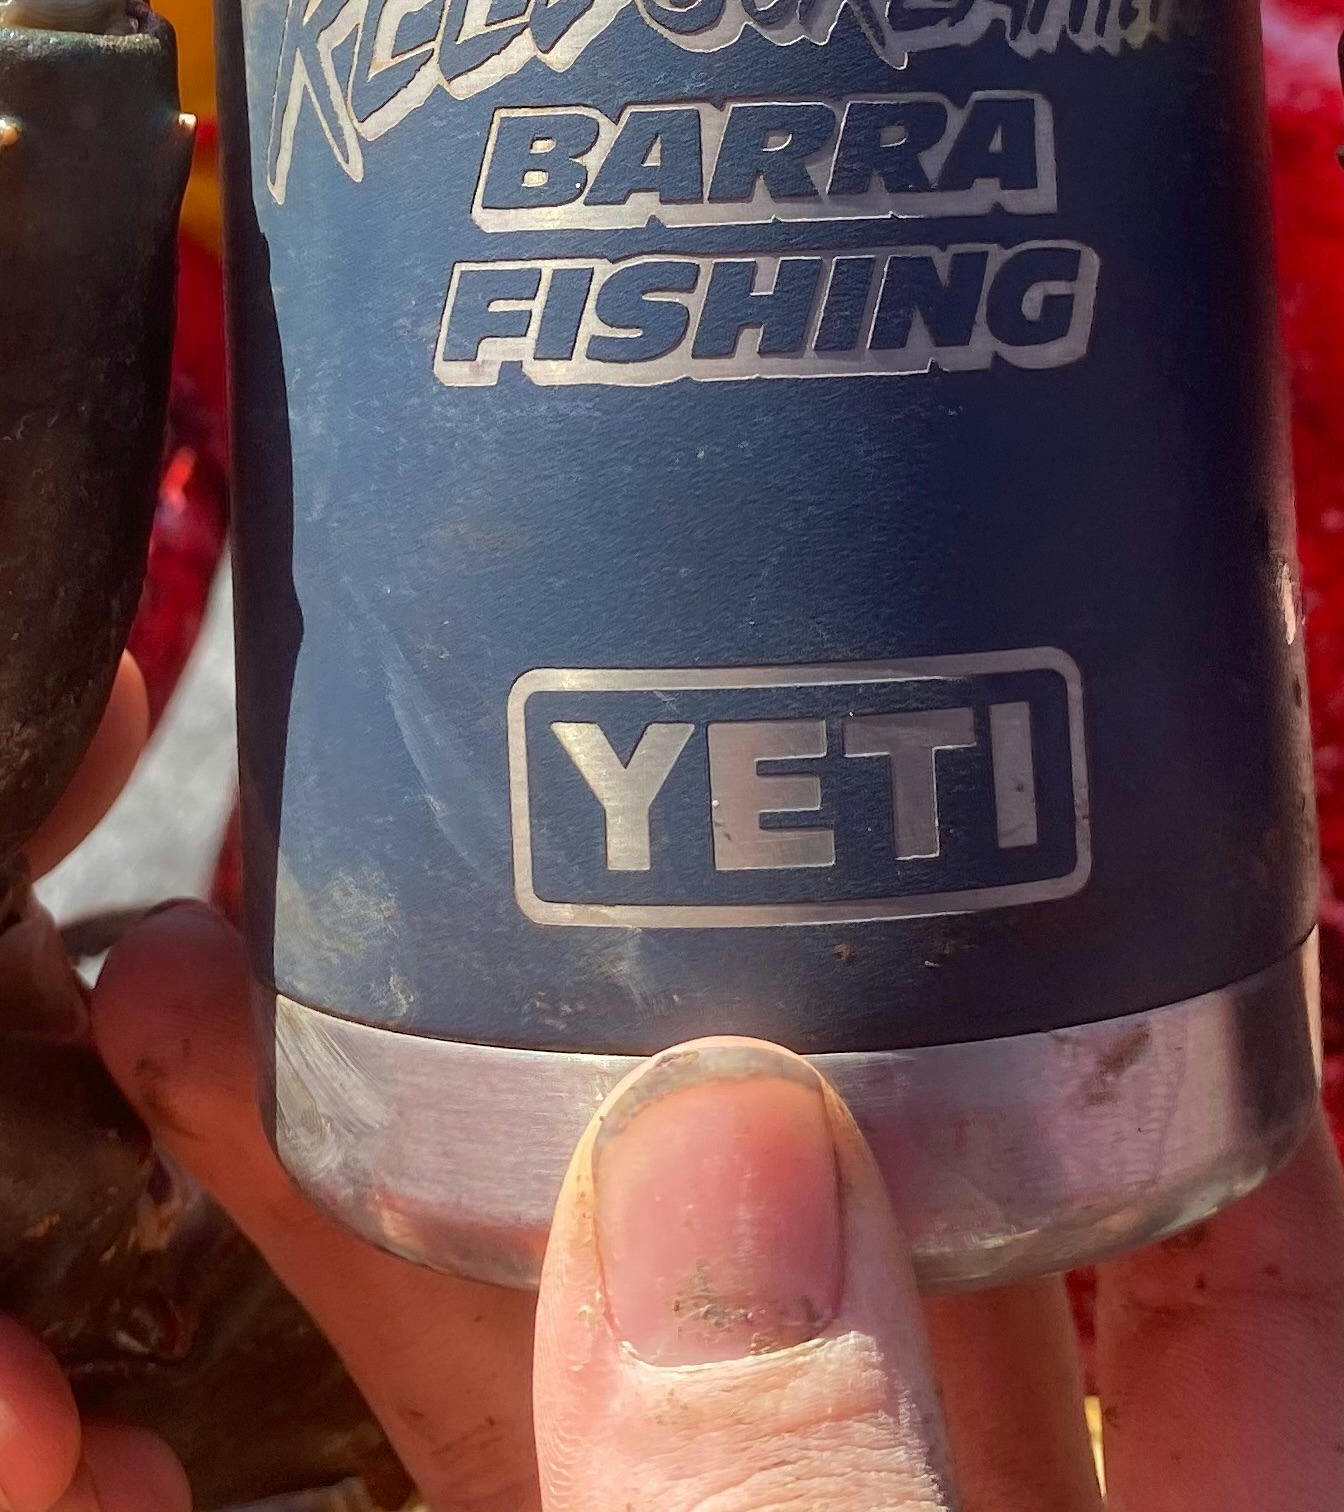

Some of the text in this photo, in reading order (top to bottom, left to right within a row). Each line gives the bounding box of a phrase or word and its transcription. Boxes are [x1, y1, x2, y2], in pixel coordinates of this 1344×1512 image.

[469, 90, 1058, 232] BARRA
[434, 240, 1101, 388] FISHING
[550, 701, 1039, 872] YETI
